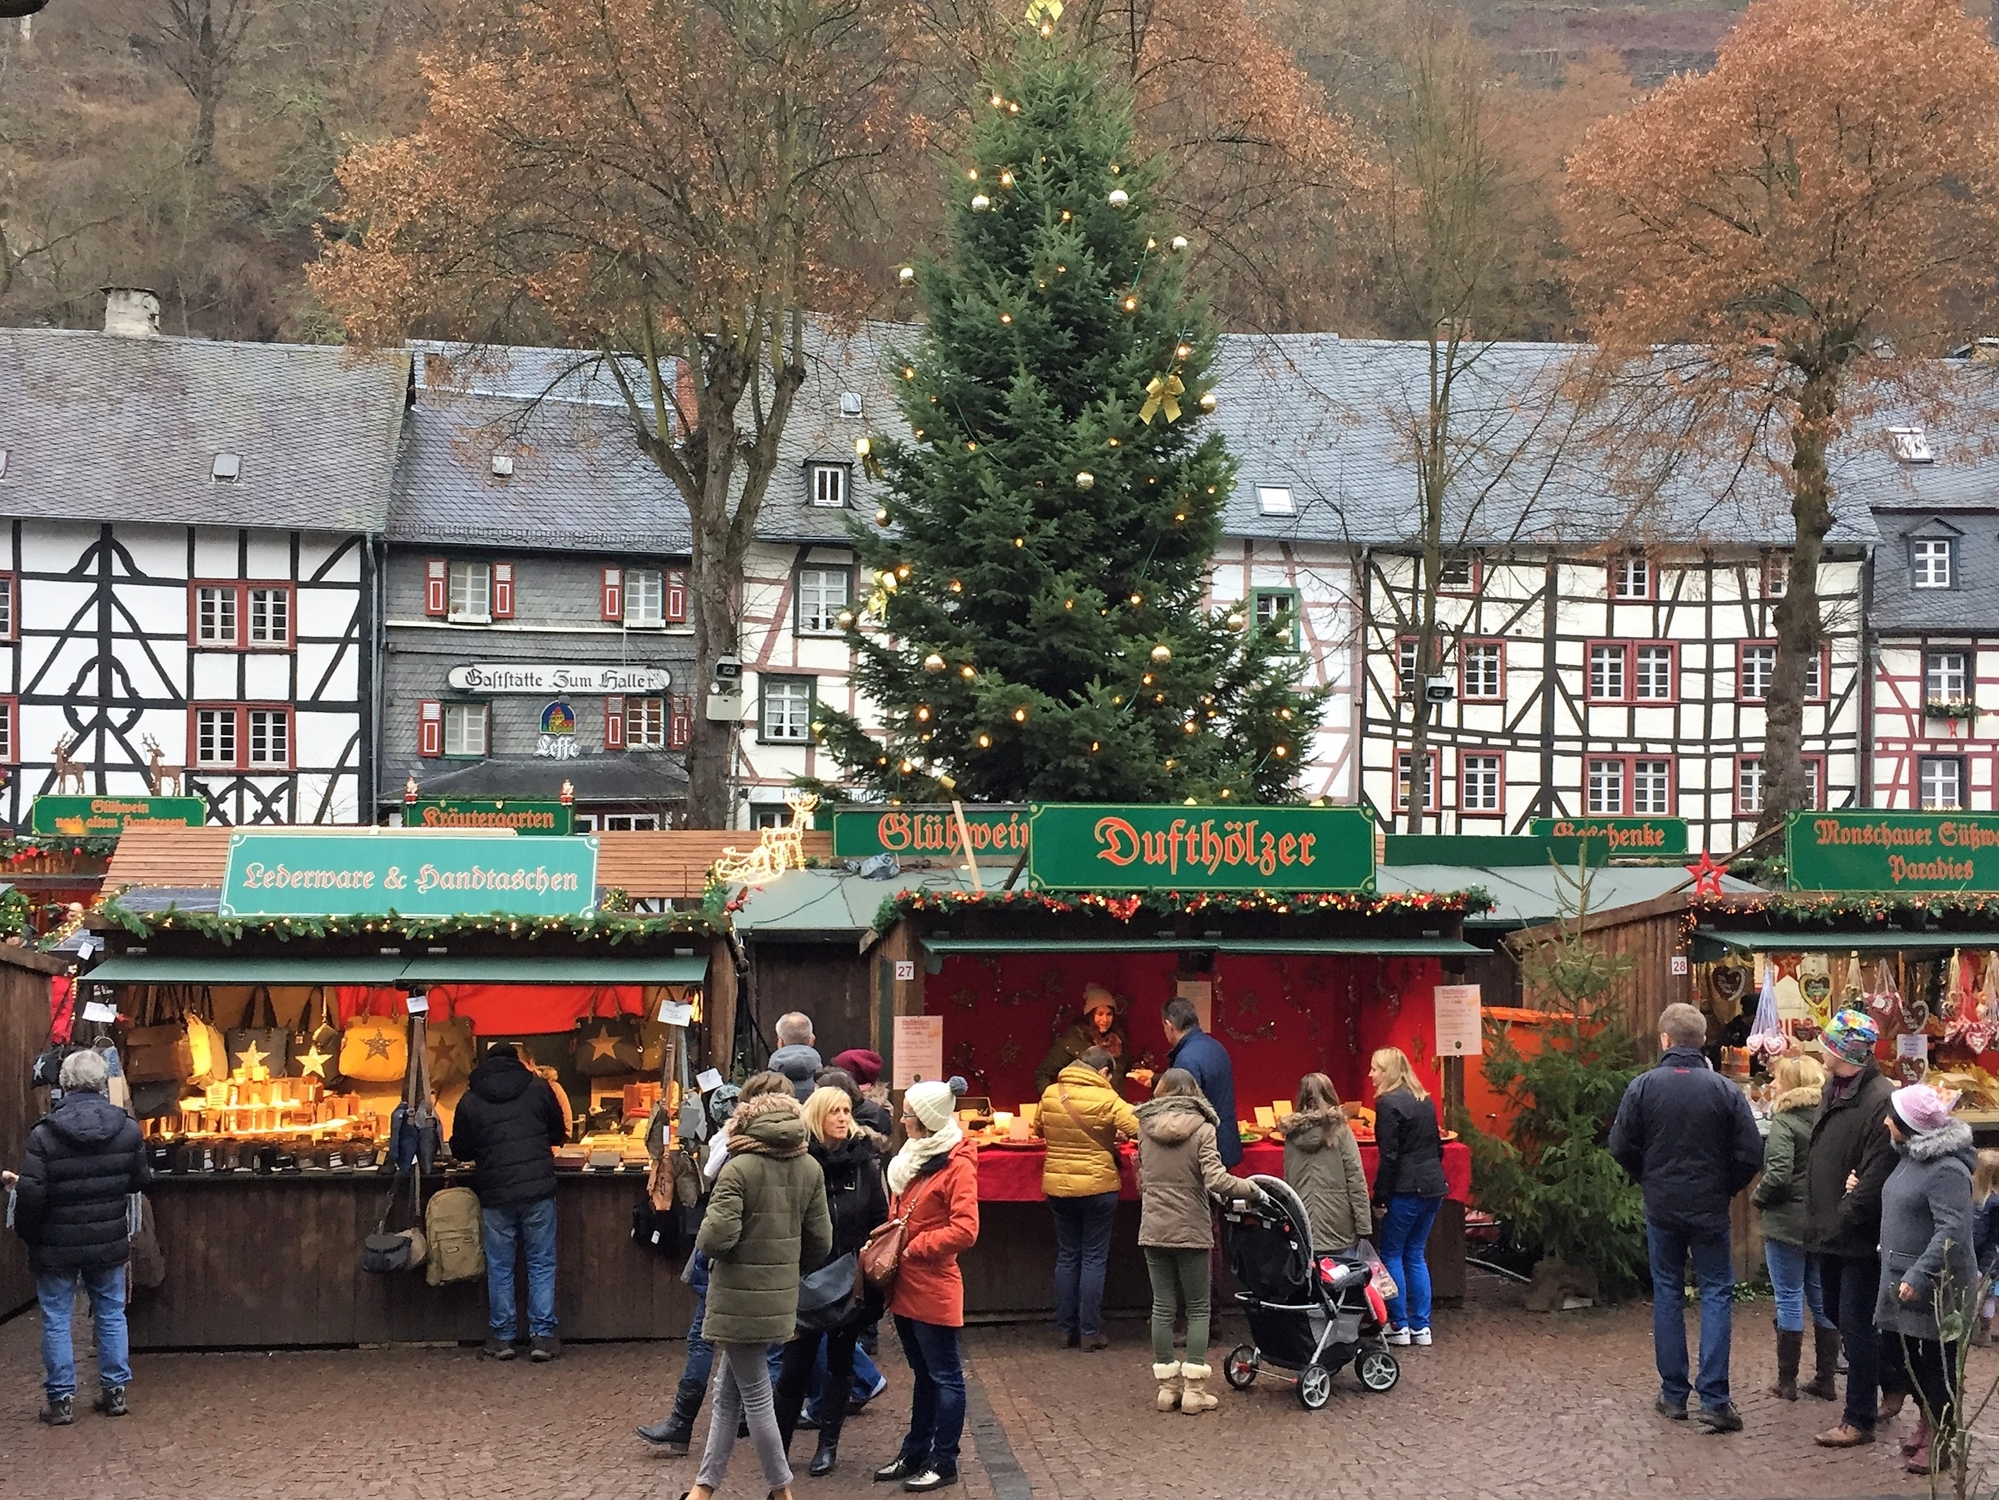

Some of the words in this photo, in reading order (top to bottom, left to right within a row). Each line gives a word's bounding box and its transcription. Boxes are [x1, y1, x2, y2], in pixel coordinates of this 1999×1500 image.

[534, 735, 583, 760] Leffe
[421, 806, 555, 829] Kräutergarten
[1094, 816, 1316, 876] Dufthölzer
[1813, 819, 1933, 850] Monschauer
[243, 862, 376, 889] Lederware
[383, 865, 407, 890] &
[415, 863, 578, 896] Handtaschen
[1888, 854, 1974, 885] Paradies
[897, 965, 913, 977] 27
[1673, 961, 1687, 972] 28
